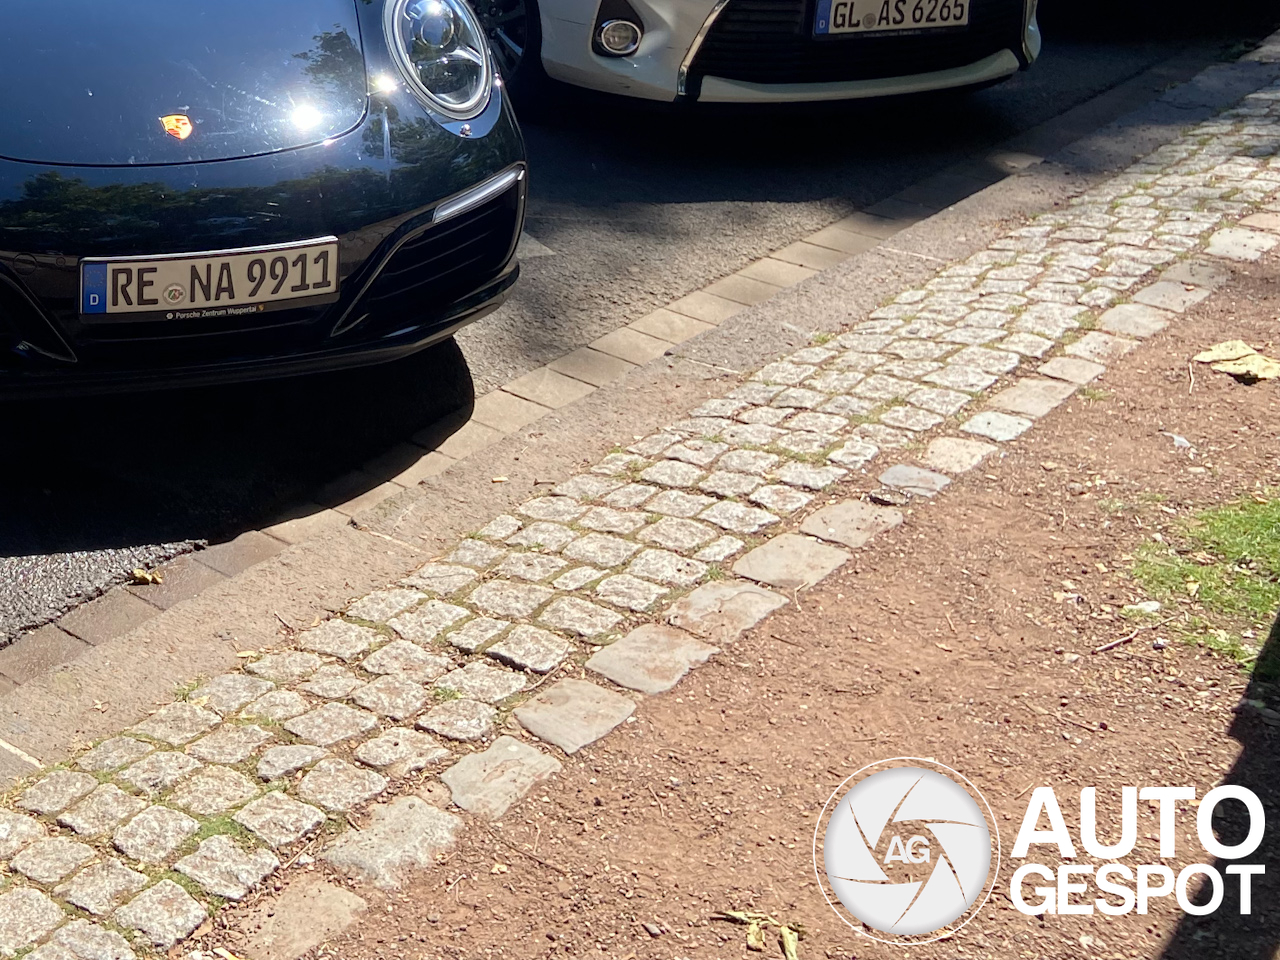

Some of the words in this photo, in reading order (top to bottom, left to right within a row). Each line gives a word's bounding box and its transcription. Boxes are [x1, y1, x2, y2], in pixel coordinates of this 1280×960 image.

[833, 1, 861, 28] GL
[89, 293, 99, 306] D
[111, 267, 158, 307] RE
[190, 262, 235, 303] NA
[247, 250, 331, 297] 9911
[175, 311, 200, 320] Porsche
[201, 307, 227, 317] Zentrum
[227, 305, 257, 315] Wuppertal
